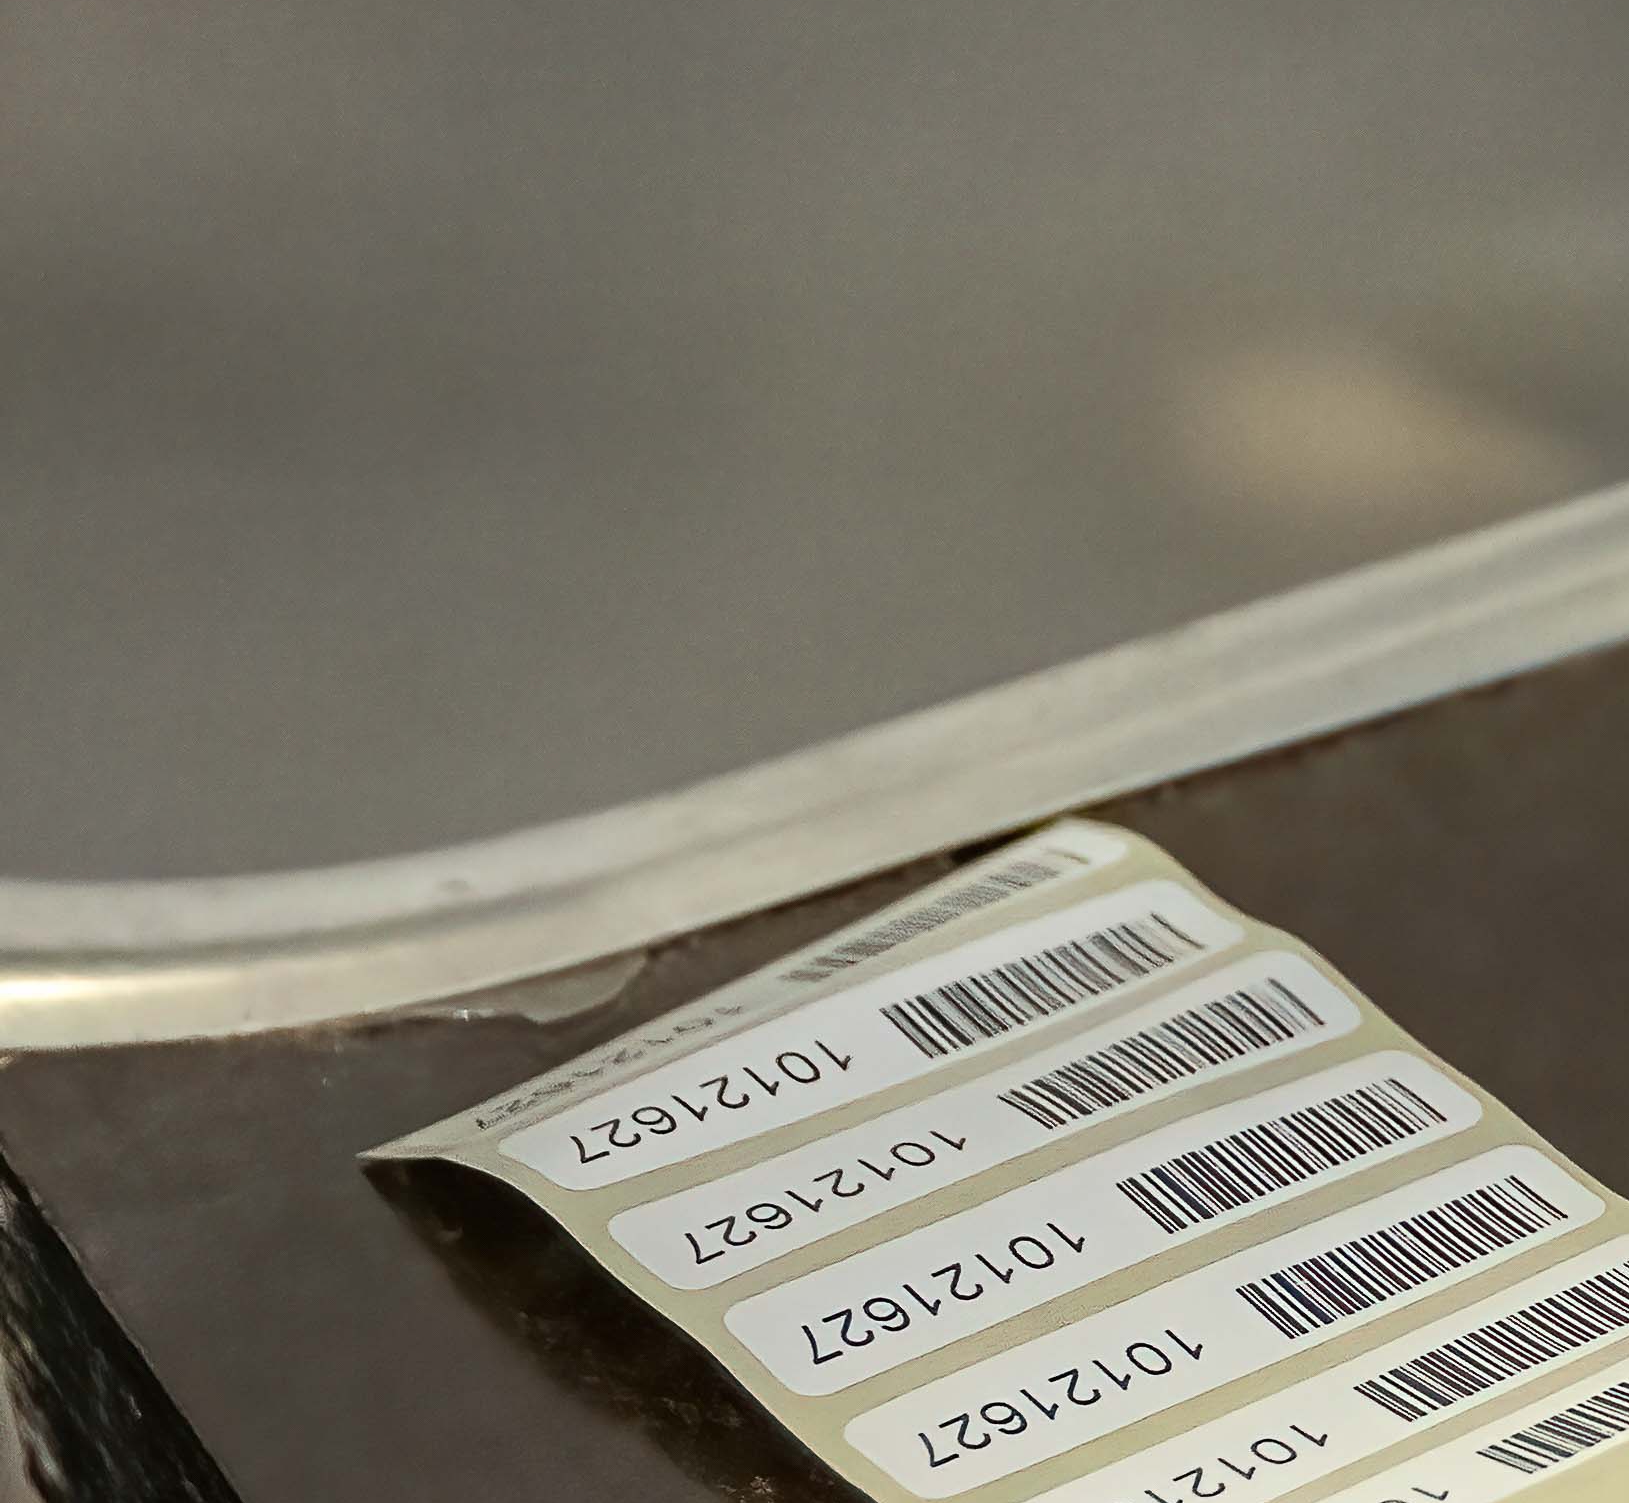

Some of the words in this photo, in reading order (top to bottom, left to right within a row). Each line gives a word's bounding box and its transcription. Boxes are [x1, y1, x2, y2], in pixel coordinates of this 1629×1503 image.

[569, 1040, 853, 1165] 10121627
[684, 1130, 968, 1266] 10121627
[800, 1222, 1086, 1366] 10121627
[917, 1328, 1205, 1469] 10121627
